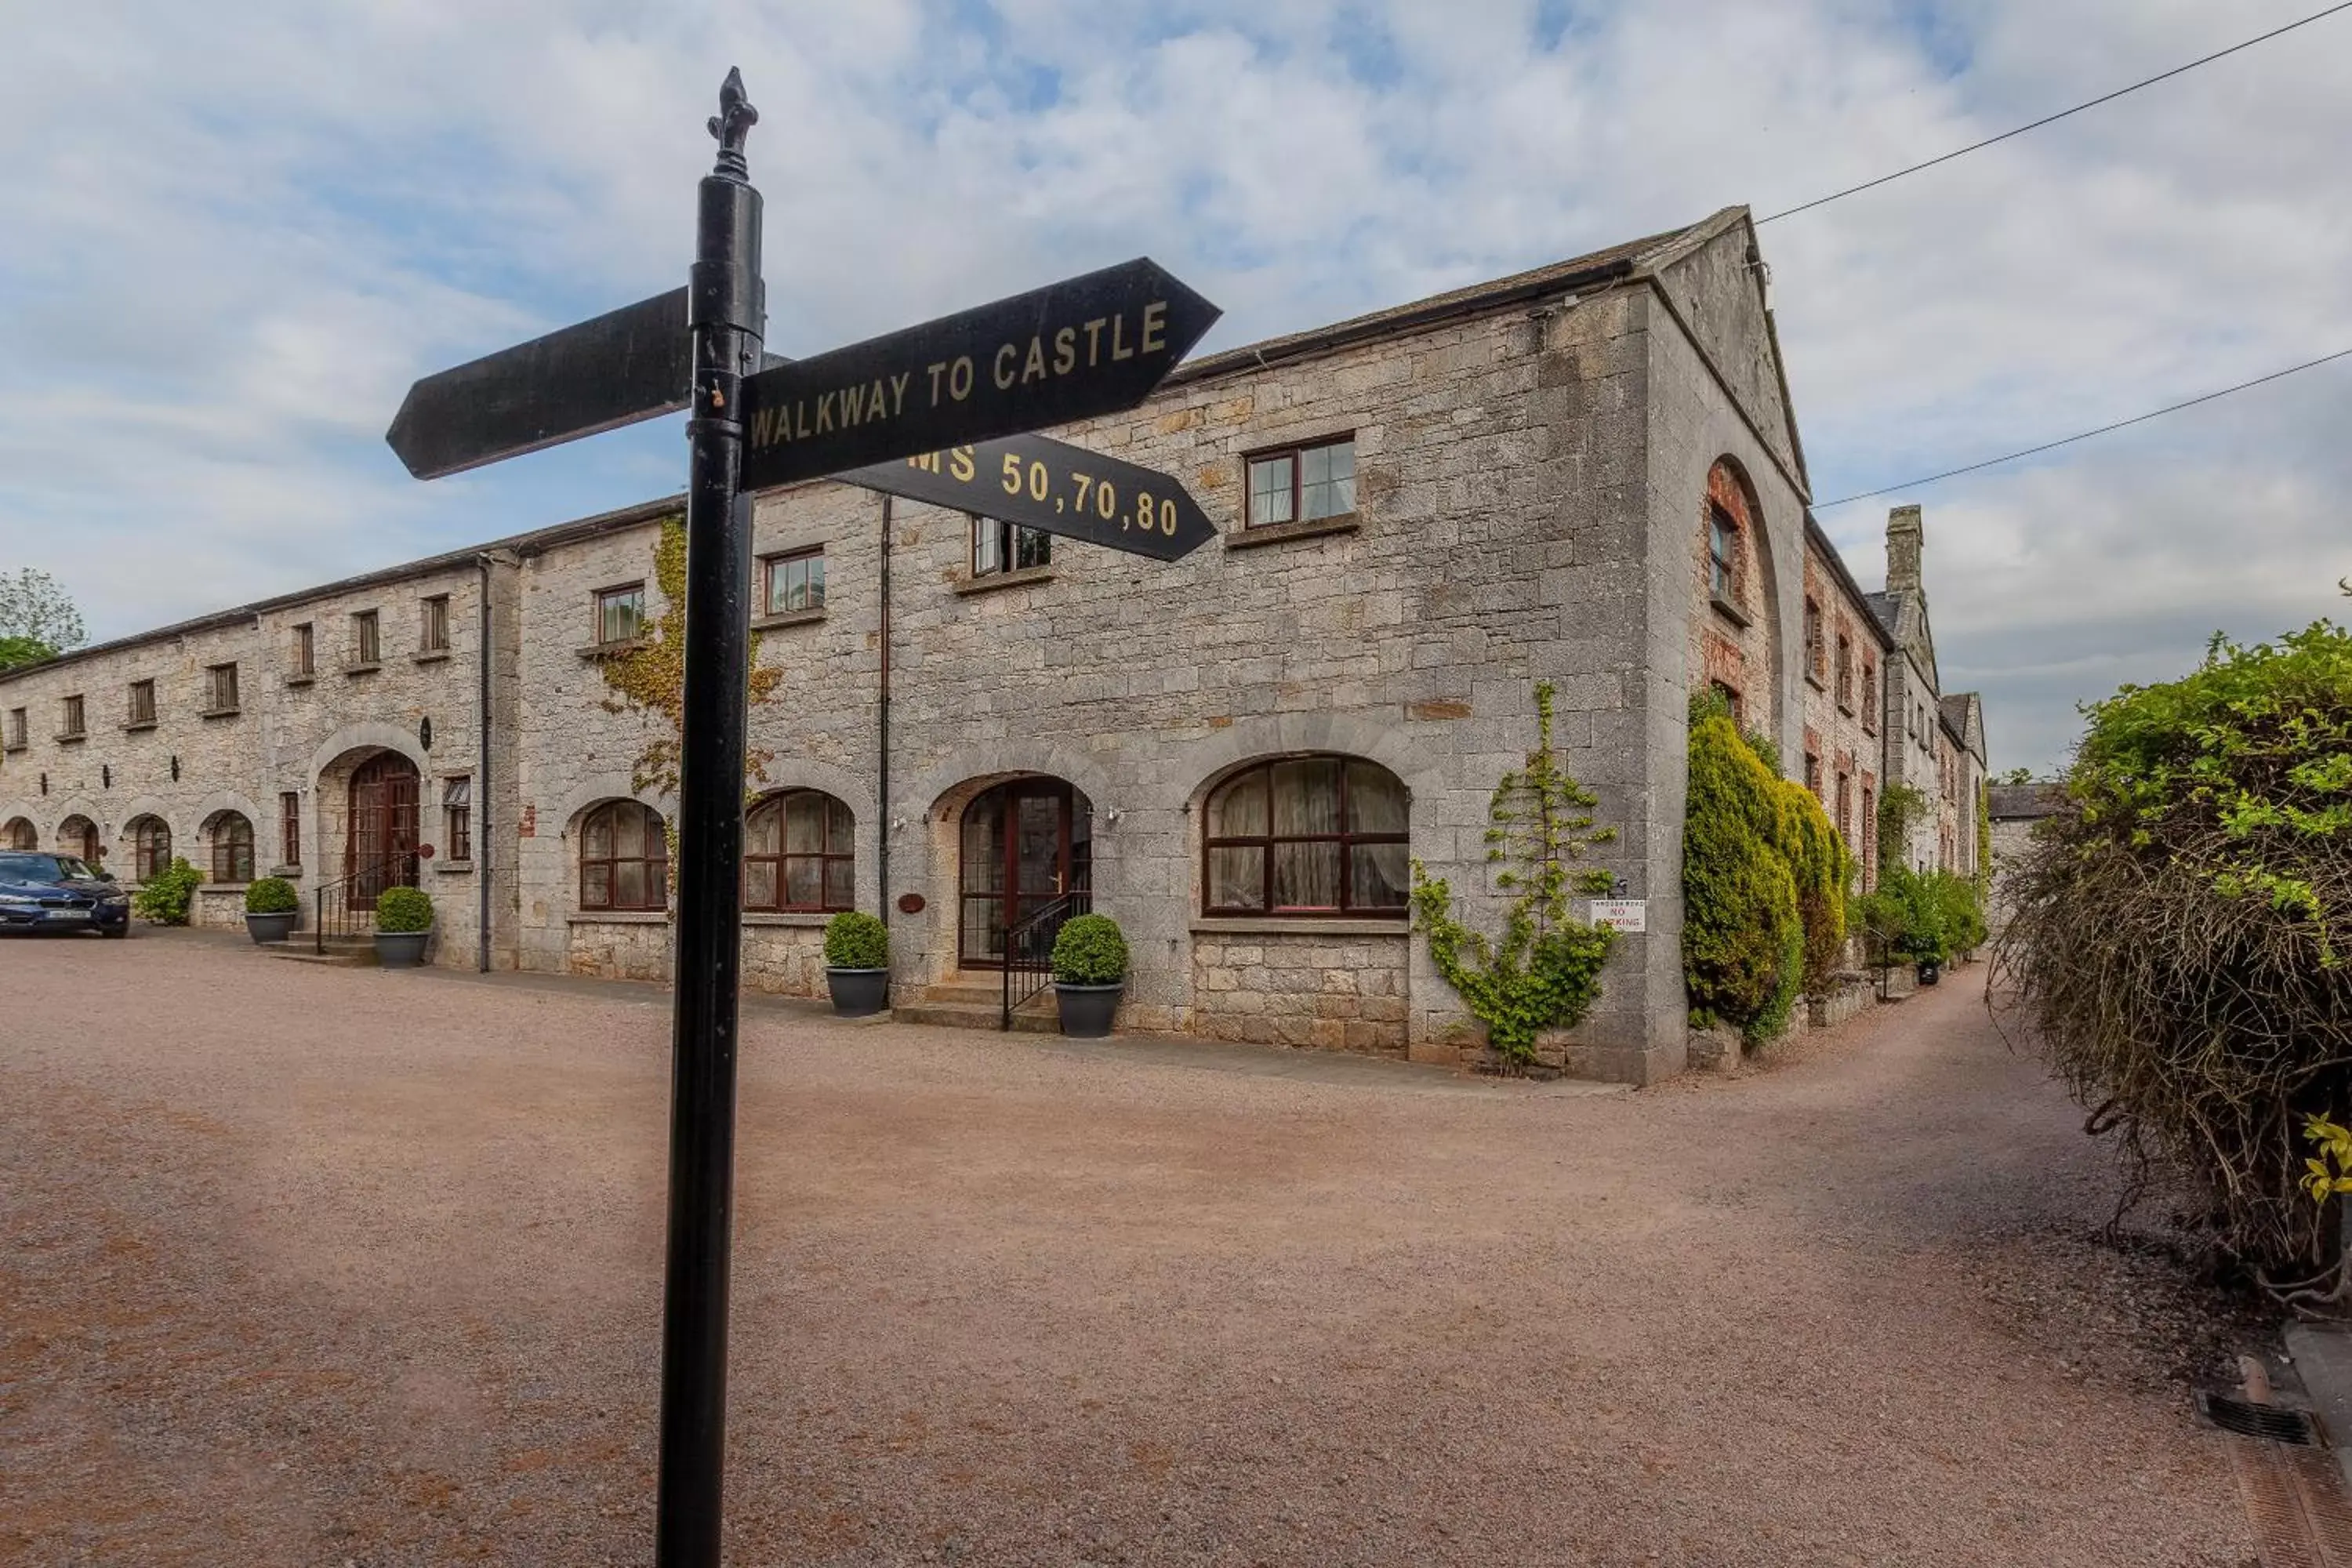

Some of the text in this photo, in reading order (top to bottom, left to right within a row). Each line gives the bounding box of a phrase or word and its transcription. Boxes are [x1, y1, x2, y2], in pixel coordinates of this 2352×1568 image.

[750, 301, 1167, 449] WALKWAY TO CASTLE
[1001, 452, 1177, 536] 50,70,80
[1610, 907, 1625, 916] NO
